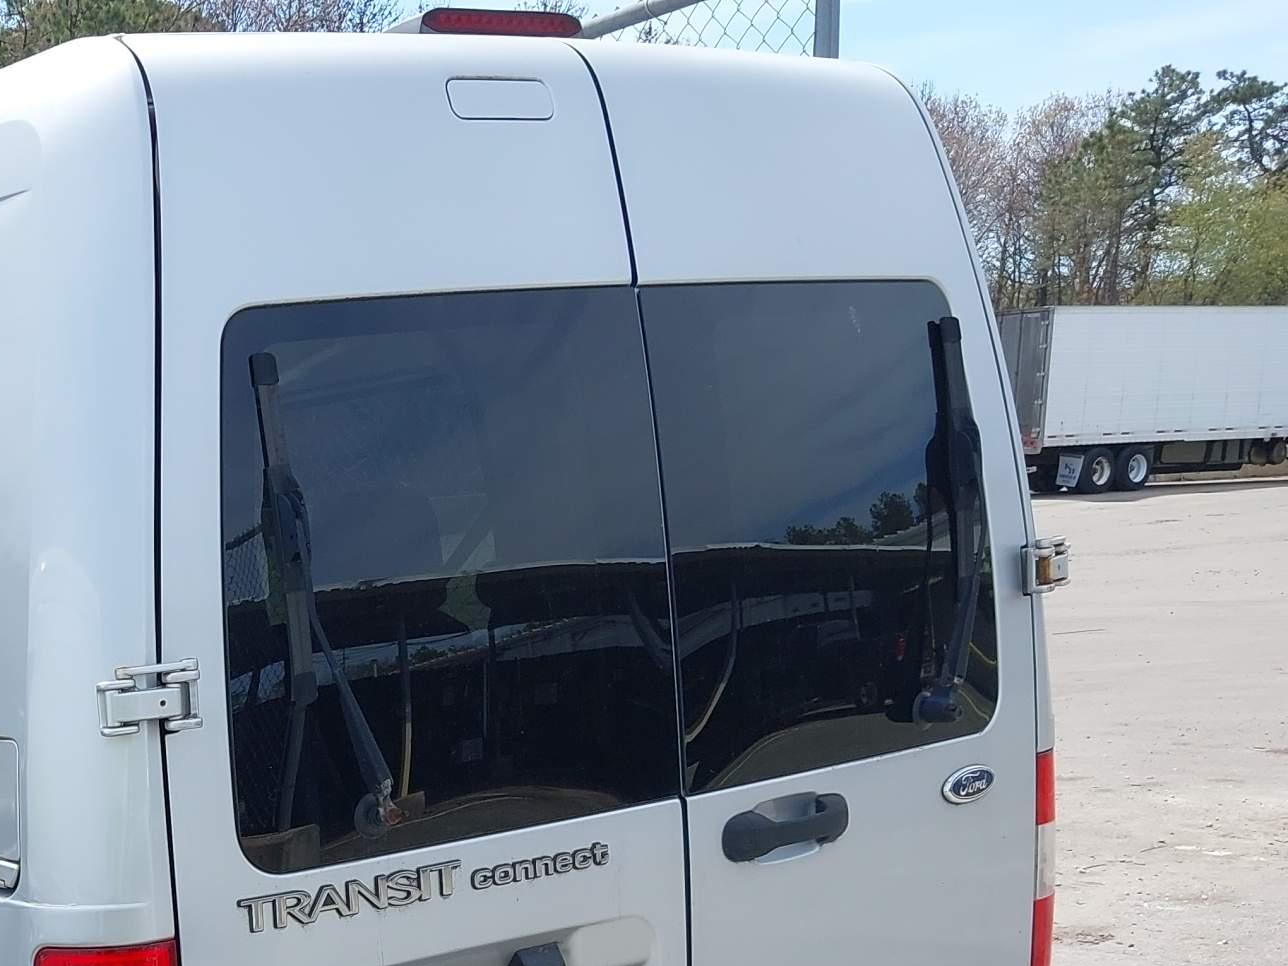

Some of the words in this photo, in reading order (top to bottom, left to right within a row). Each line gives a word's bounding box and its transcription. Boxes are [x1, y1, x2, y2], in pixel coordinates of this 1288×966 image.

[958, 770, 989, 797] Ford
[237, 859, 462, 933] TRANSIT
[471, 842, 610, 890] connect
